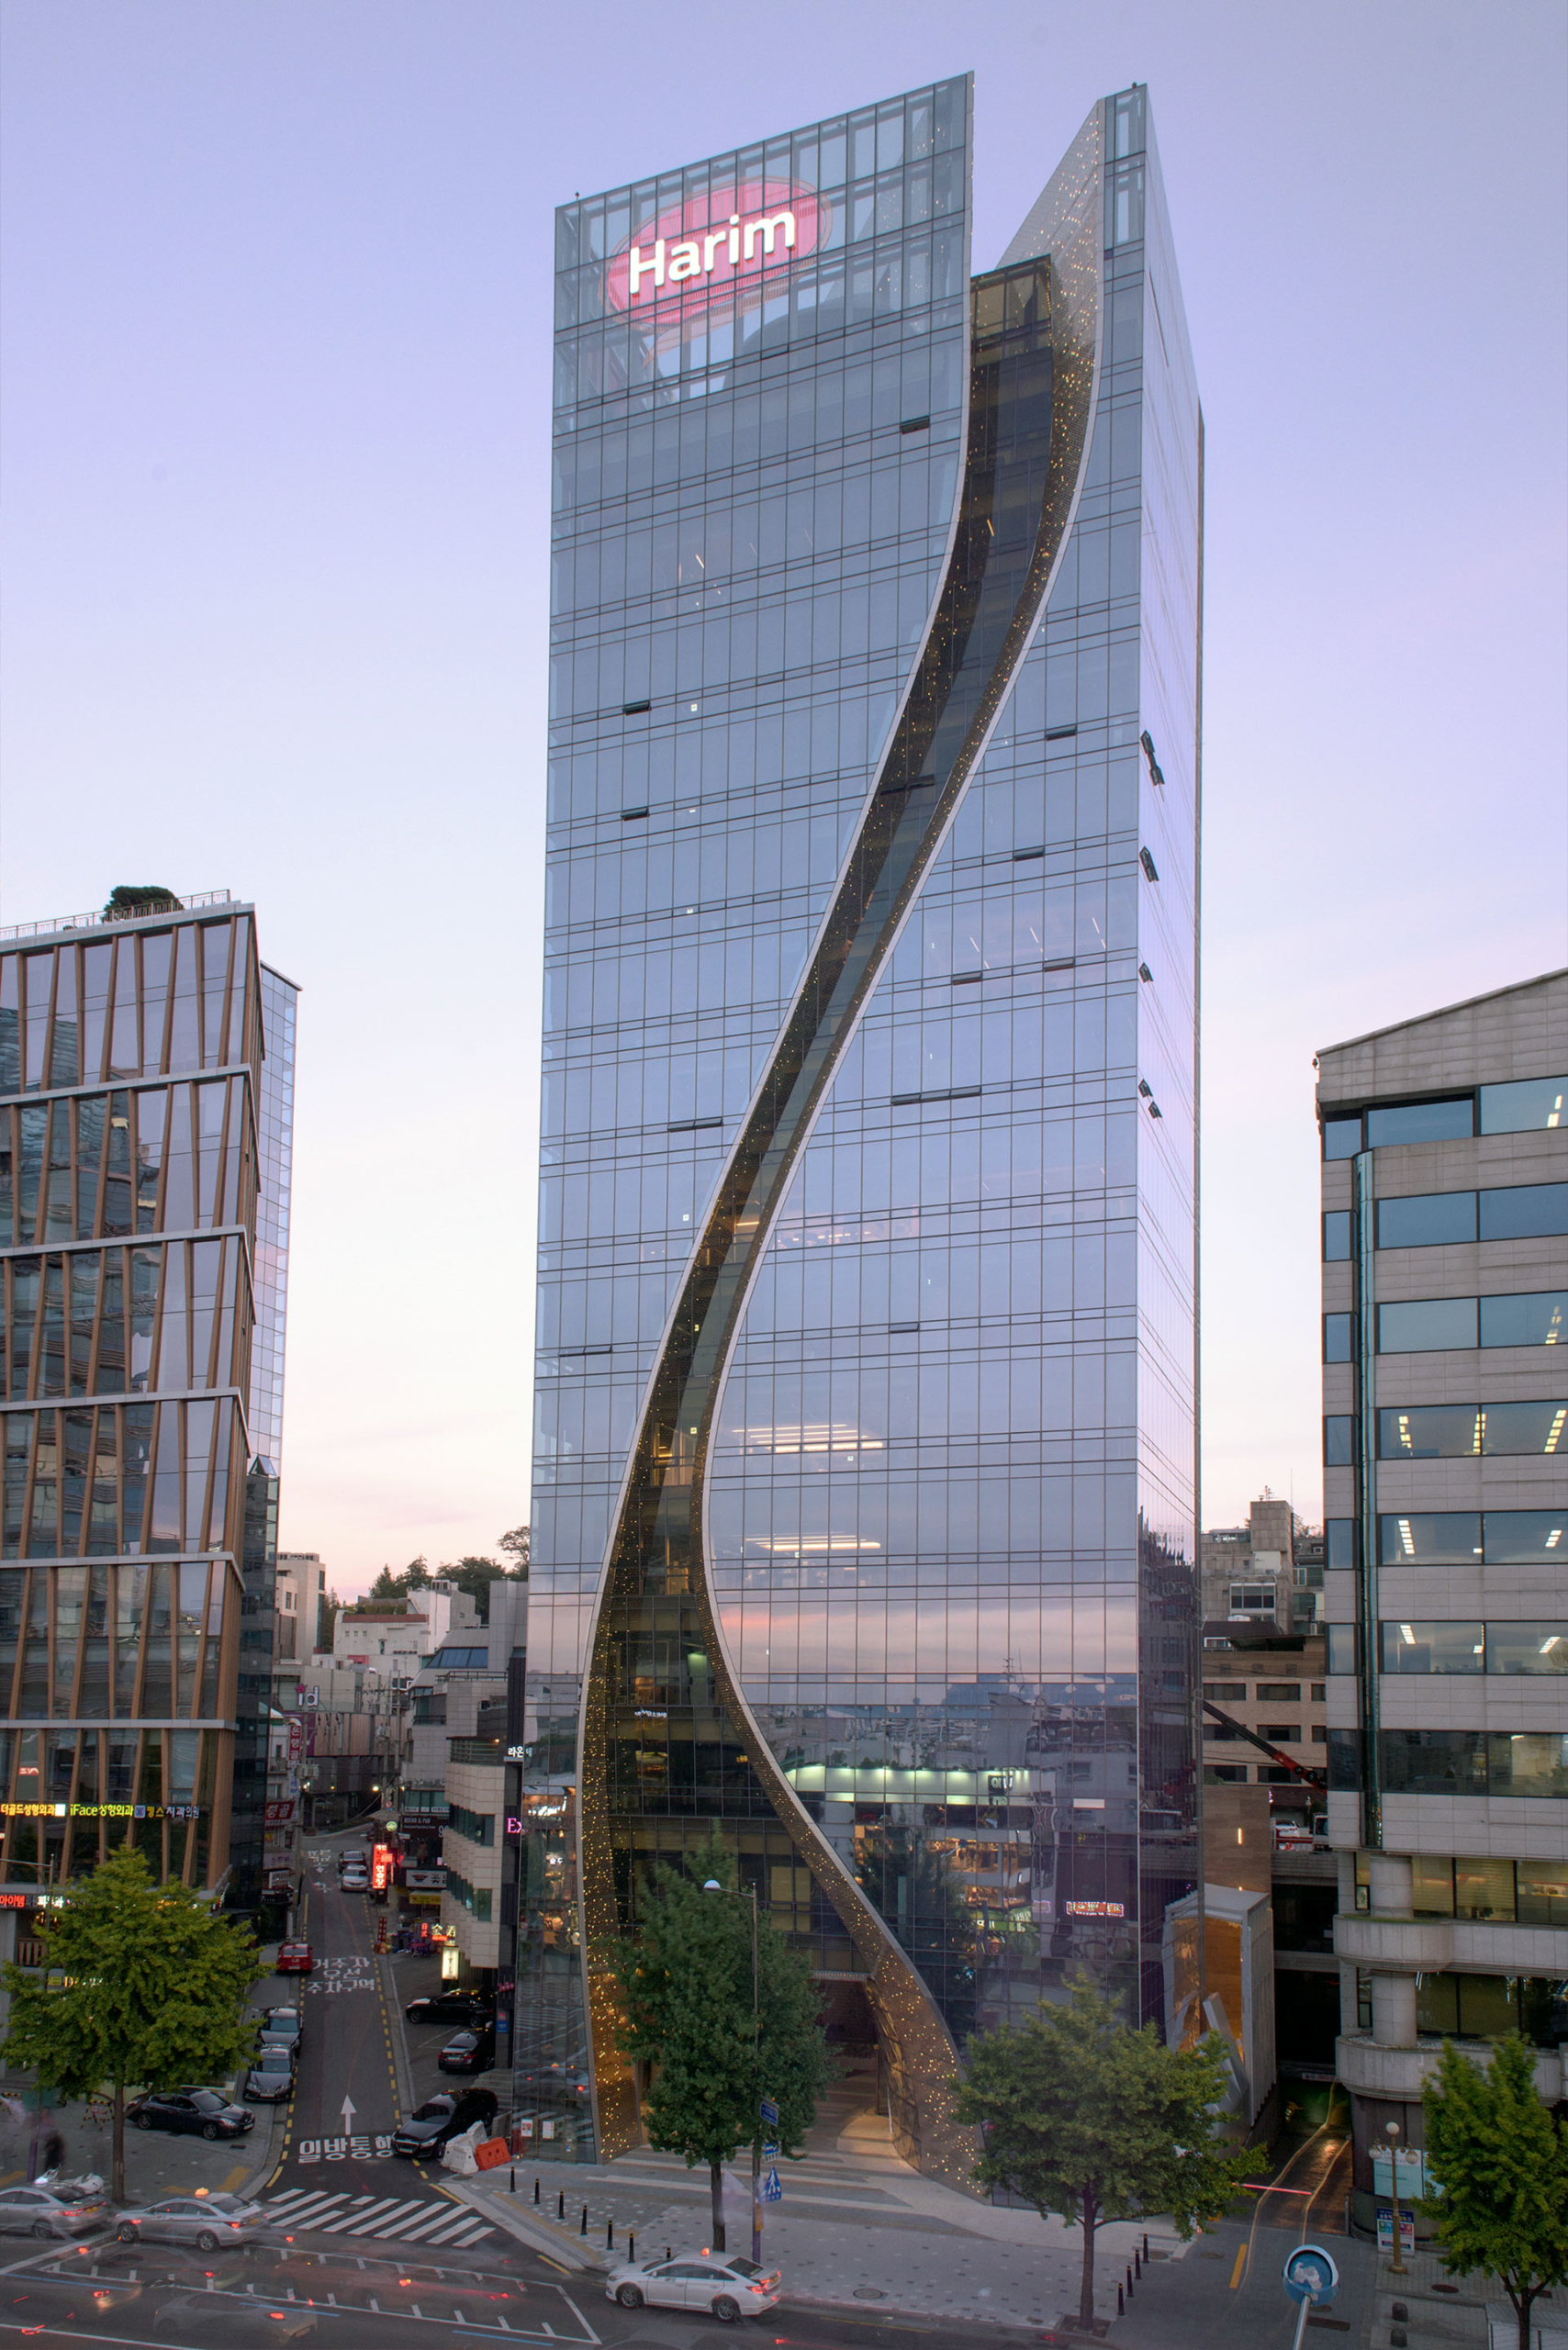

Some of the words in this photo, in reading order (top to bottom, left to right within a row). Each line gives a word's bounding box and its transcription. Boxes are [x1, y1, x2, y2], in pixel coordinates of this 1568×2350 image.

[629, 210, 796, 294] Harim
[295, 1684, 319, 1707] id
[0, 1803, 55, 1817] 더골드성형외과
[312, 1957, 370, 1970] 거주자
[322, 1968, 361, 1980] 우선
[307, 1978, 375, 1994] 주차구역
